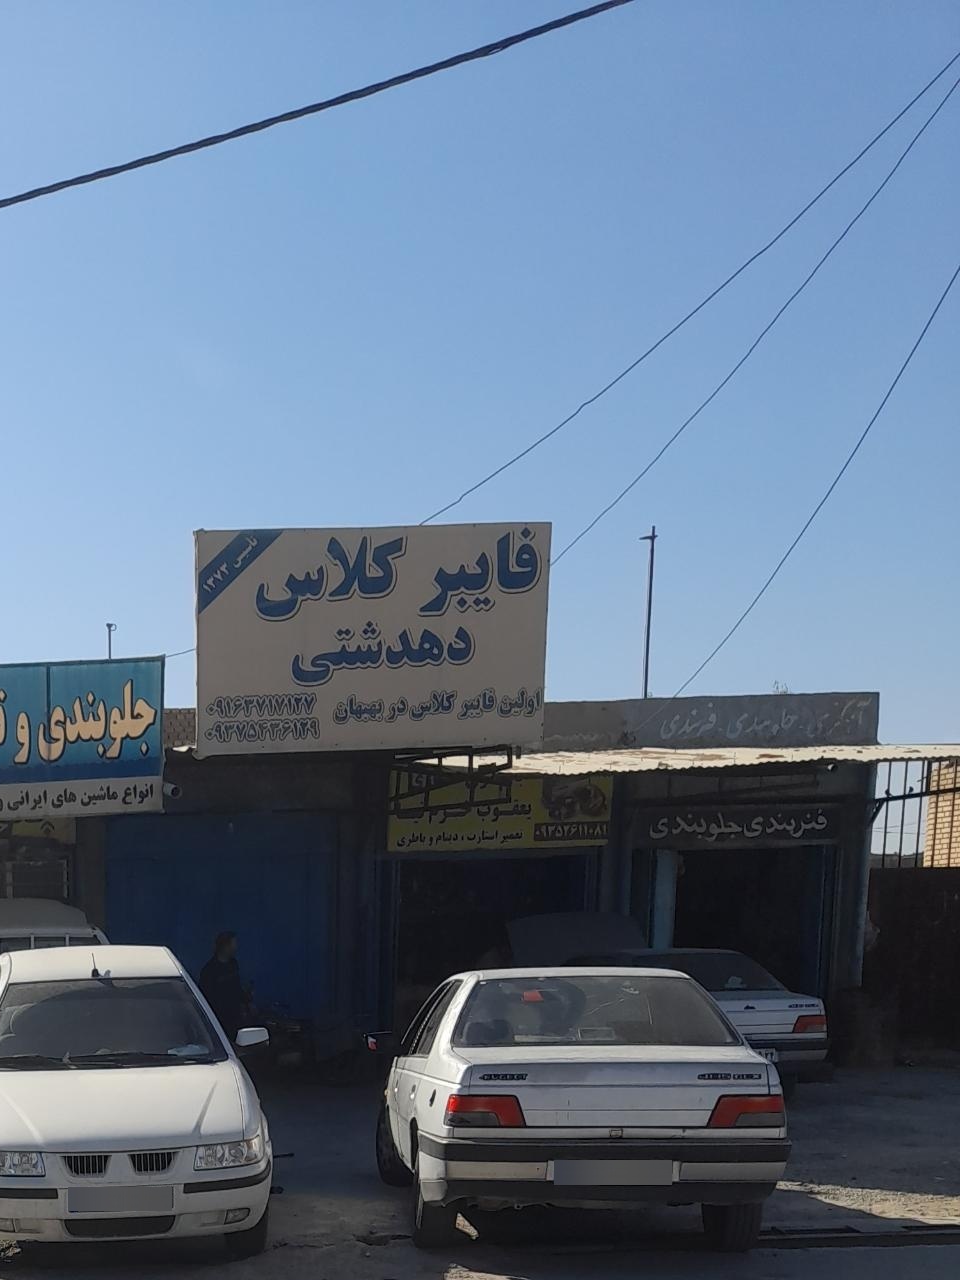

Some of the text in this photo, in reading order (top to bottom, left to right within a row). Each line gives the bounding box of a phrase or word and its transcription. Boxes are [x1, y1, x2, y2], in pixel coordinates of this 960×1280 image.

[203, 562, 230, 592] ۱۳۷۳
[255, 527, 541, 621] فایبر کلاس
[291, 620, 475, 686] دهدشتی
[37, 679, 157, 762] جلوبندی
[333, 687, 542, 725] اولین فایبر کلاس در بهبهان
[13, 711, 31, 764] و
[7, 789, 48, 811] ایرانی
[51, 789, 76, 807] های
[80, 784, 119, 806] ماشین
[121, 783, 154, 805] انواع
[649, 808, 828, 842] فنربندی جلوبندی
